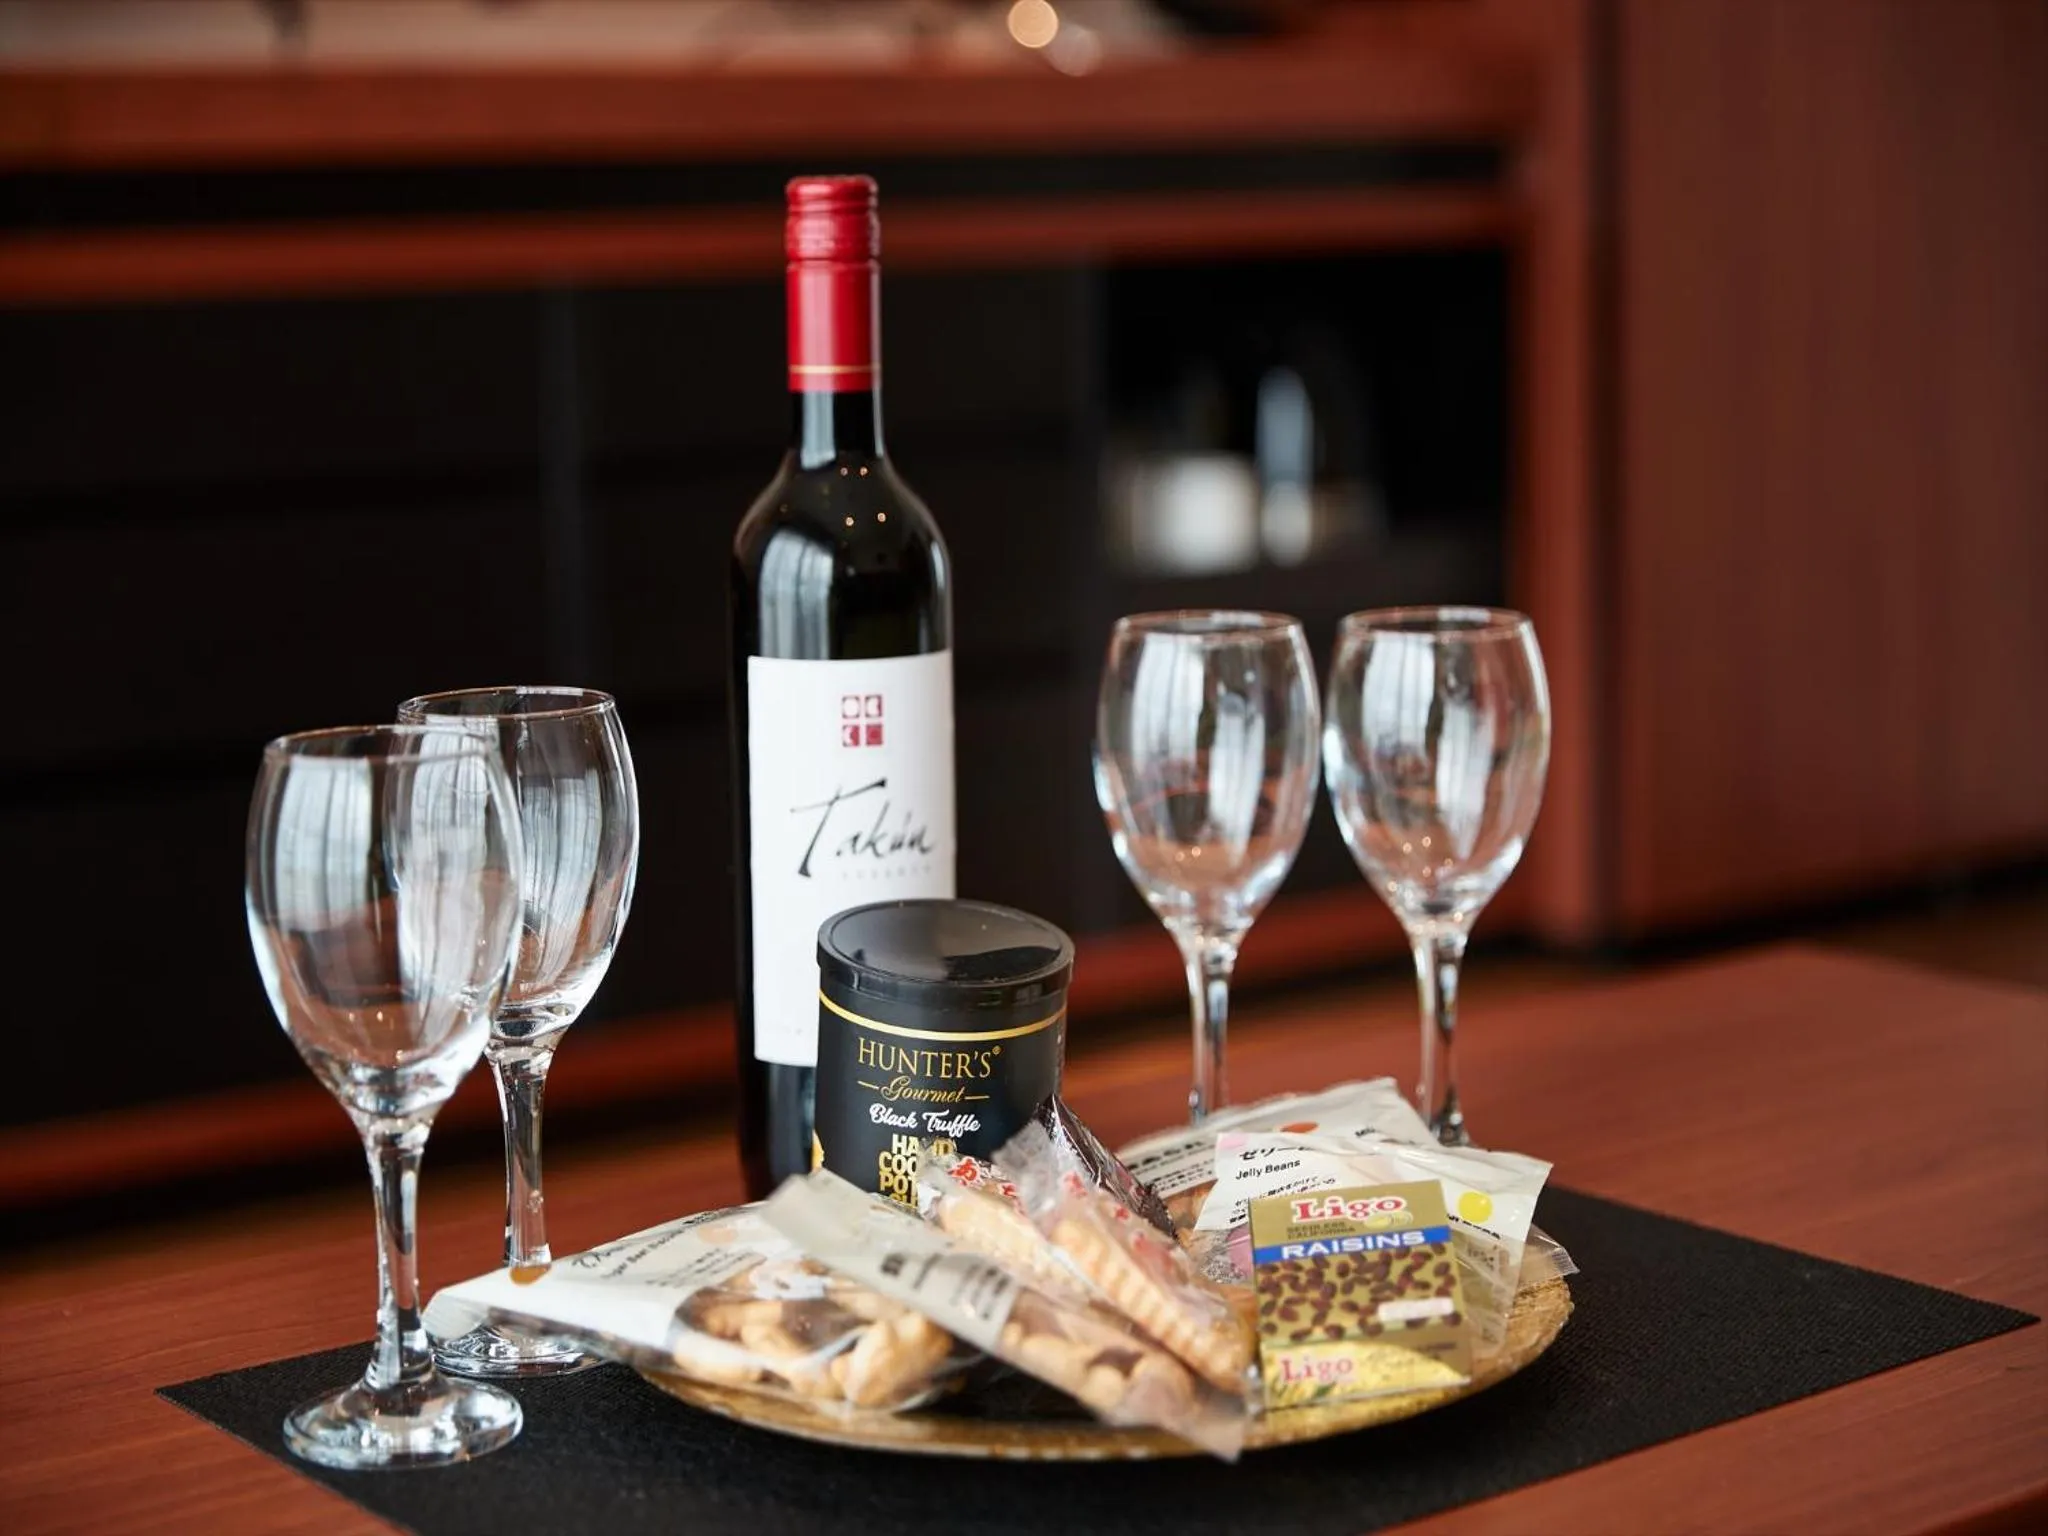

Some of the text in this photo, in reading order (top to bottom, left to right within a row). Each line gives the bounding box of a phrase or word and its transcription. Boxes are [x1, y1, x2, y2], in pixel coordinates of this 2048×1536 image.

[880, 1075, 964, 1103] Gourmet
[869, 1103, 981, 1138] Black Truffle
[1235, 1159, 1301, 1181] Jelly Beans
[1290, 1195, 1407, 1223] Ligo
[1281, 1231, 1425, 1260] RAISINS
[1280, 1356, 1354, 1384] Ligo
